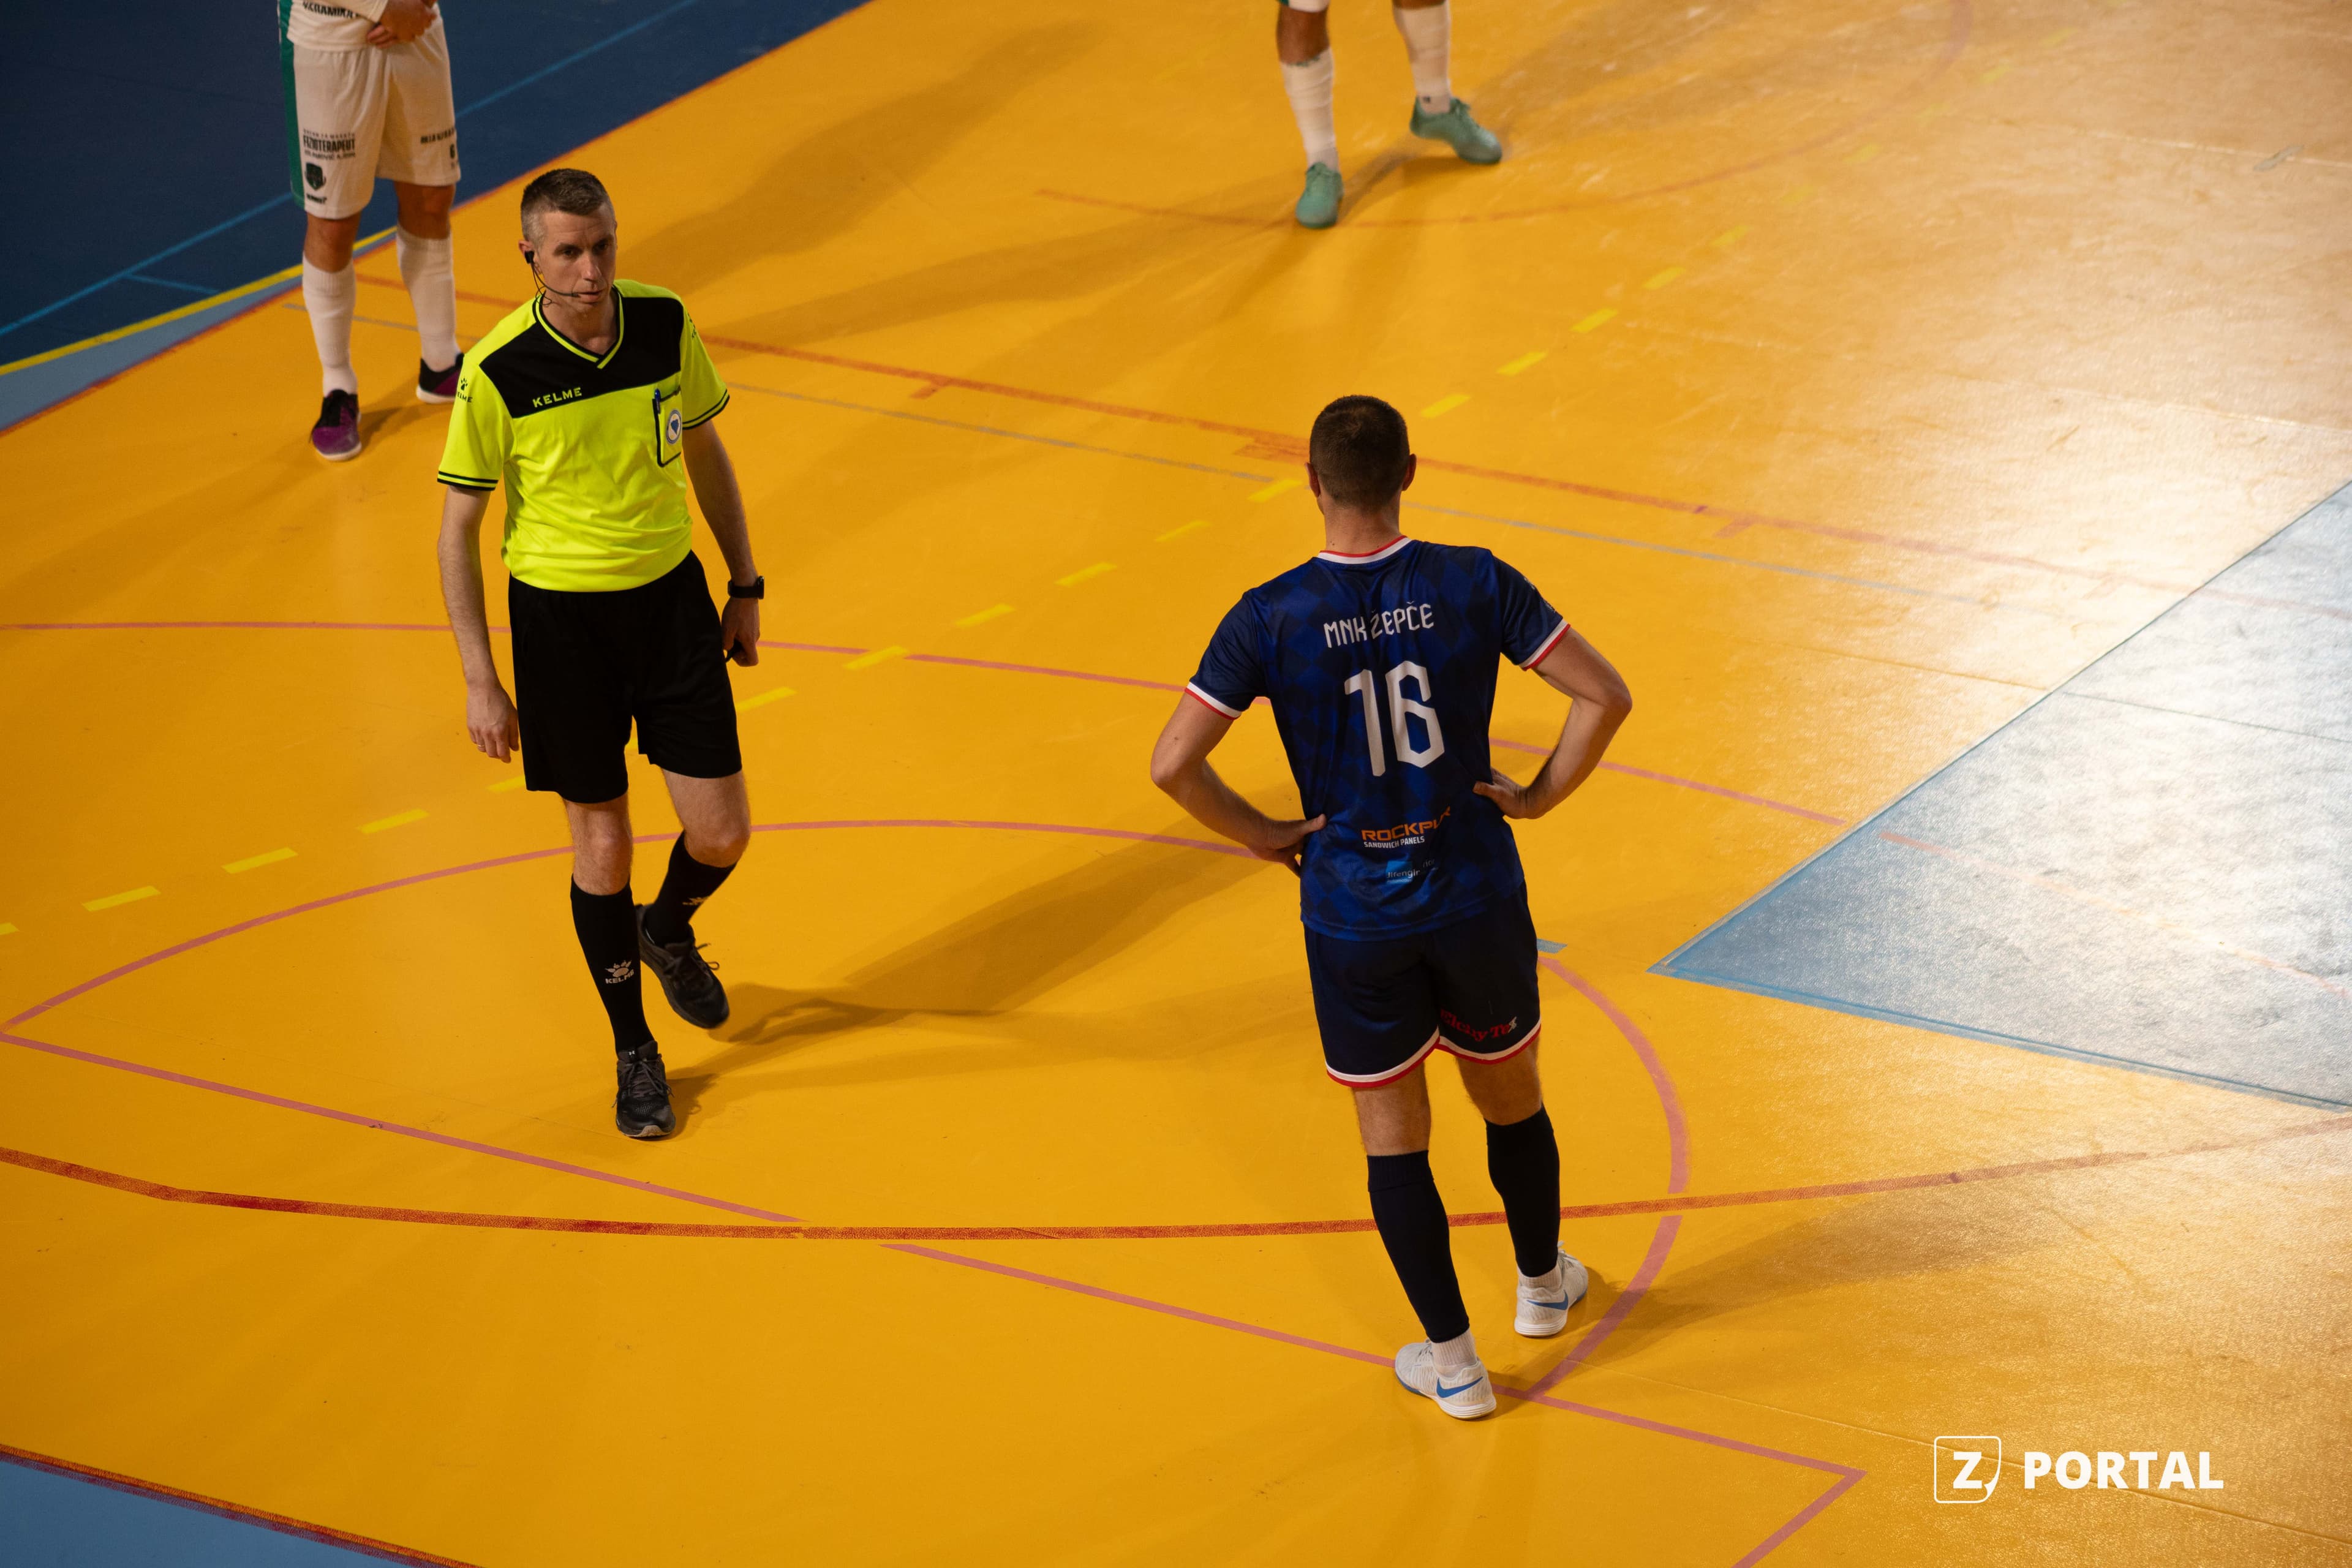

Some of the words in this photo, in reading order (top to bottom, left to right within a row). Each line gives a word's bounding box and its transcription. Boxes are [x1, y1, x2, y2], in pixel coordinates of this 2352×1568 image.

[457, 391, 473, 402] ELME
[532, 386, 582, 408] KELME
[1323, 616, 1368, 648] MNK
[1370, 601, 1434, 639] ŽEPČE
[1344, 660, 1445, 777] 16
[1363, 840, 1400, 849] SANDWICH
[1400, 835, 1425, 846] PANELS
[605, 969, 635, 984] KELME
